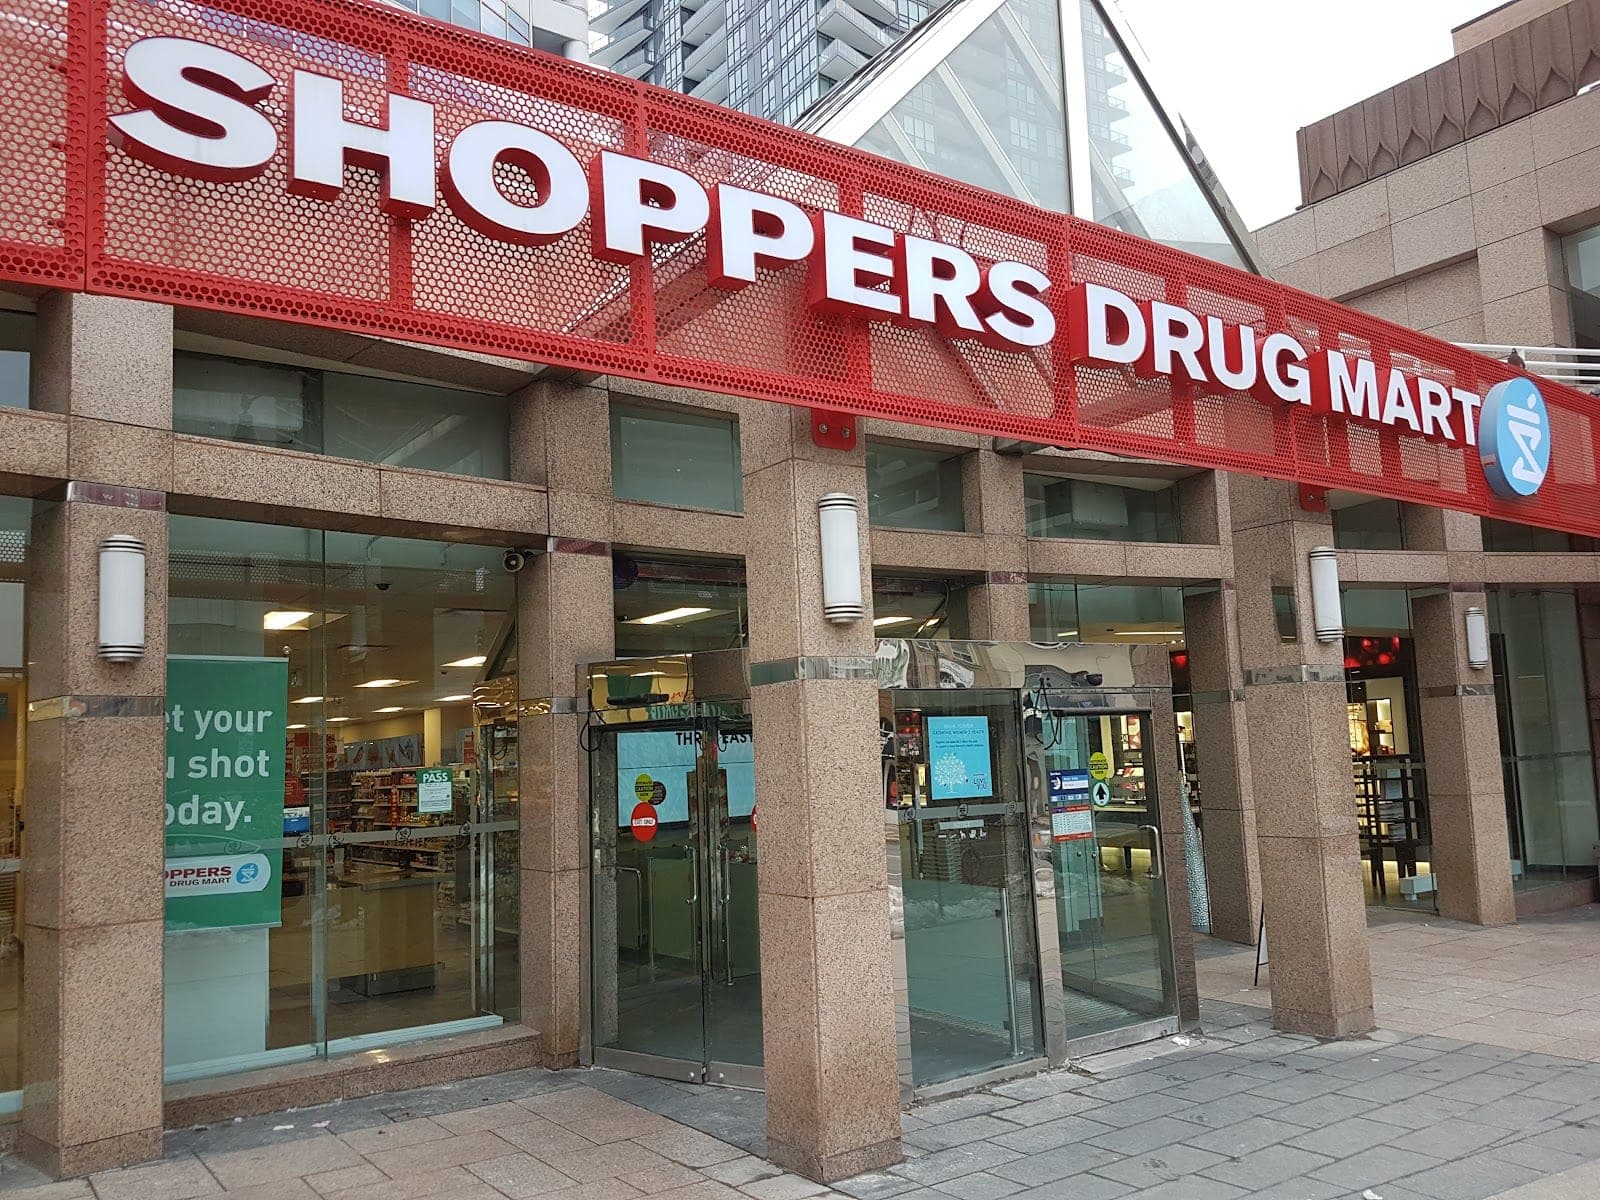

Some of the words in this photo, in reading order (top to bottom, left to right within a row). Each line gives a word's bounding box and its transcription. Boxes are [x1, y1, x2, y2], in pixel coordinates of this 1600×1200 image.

[107, 35, 1057, 348] SHOPPERS
[1086, 282, 1312, 406] DRUG
[1327, 350, 1482, 447] MART
[193, 710, 273, 741] your
[187, 748, 269, 779] shot
[422, 772, 449, 783] PASS
[169, 879, 200, 887] DRUG
[202, 877, 231, 885] MART
